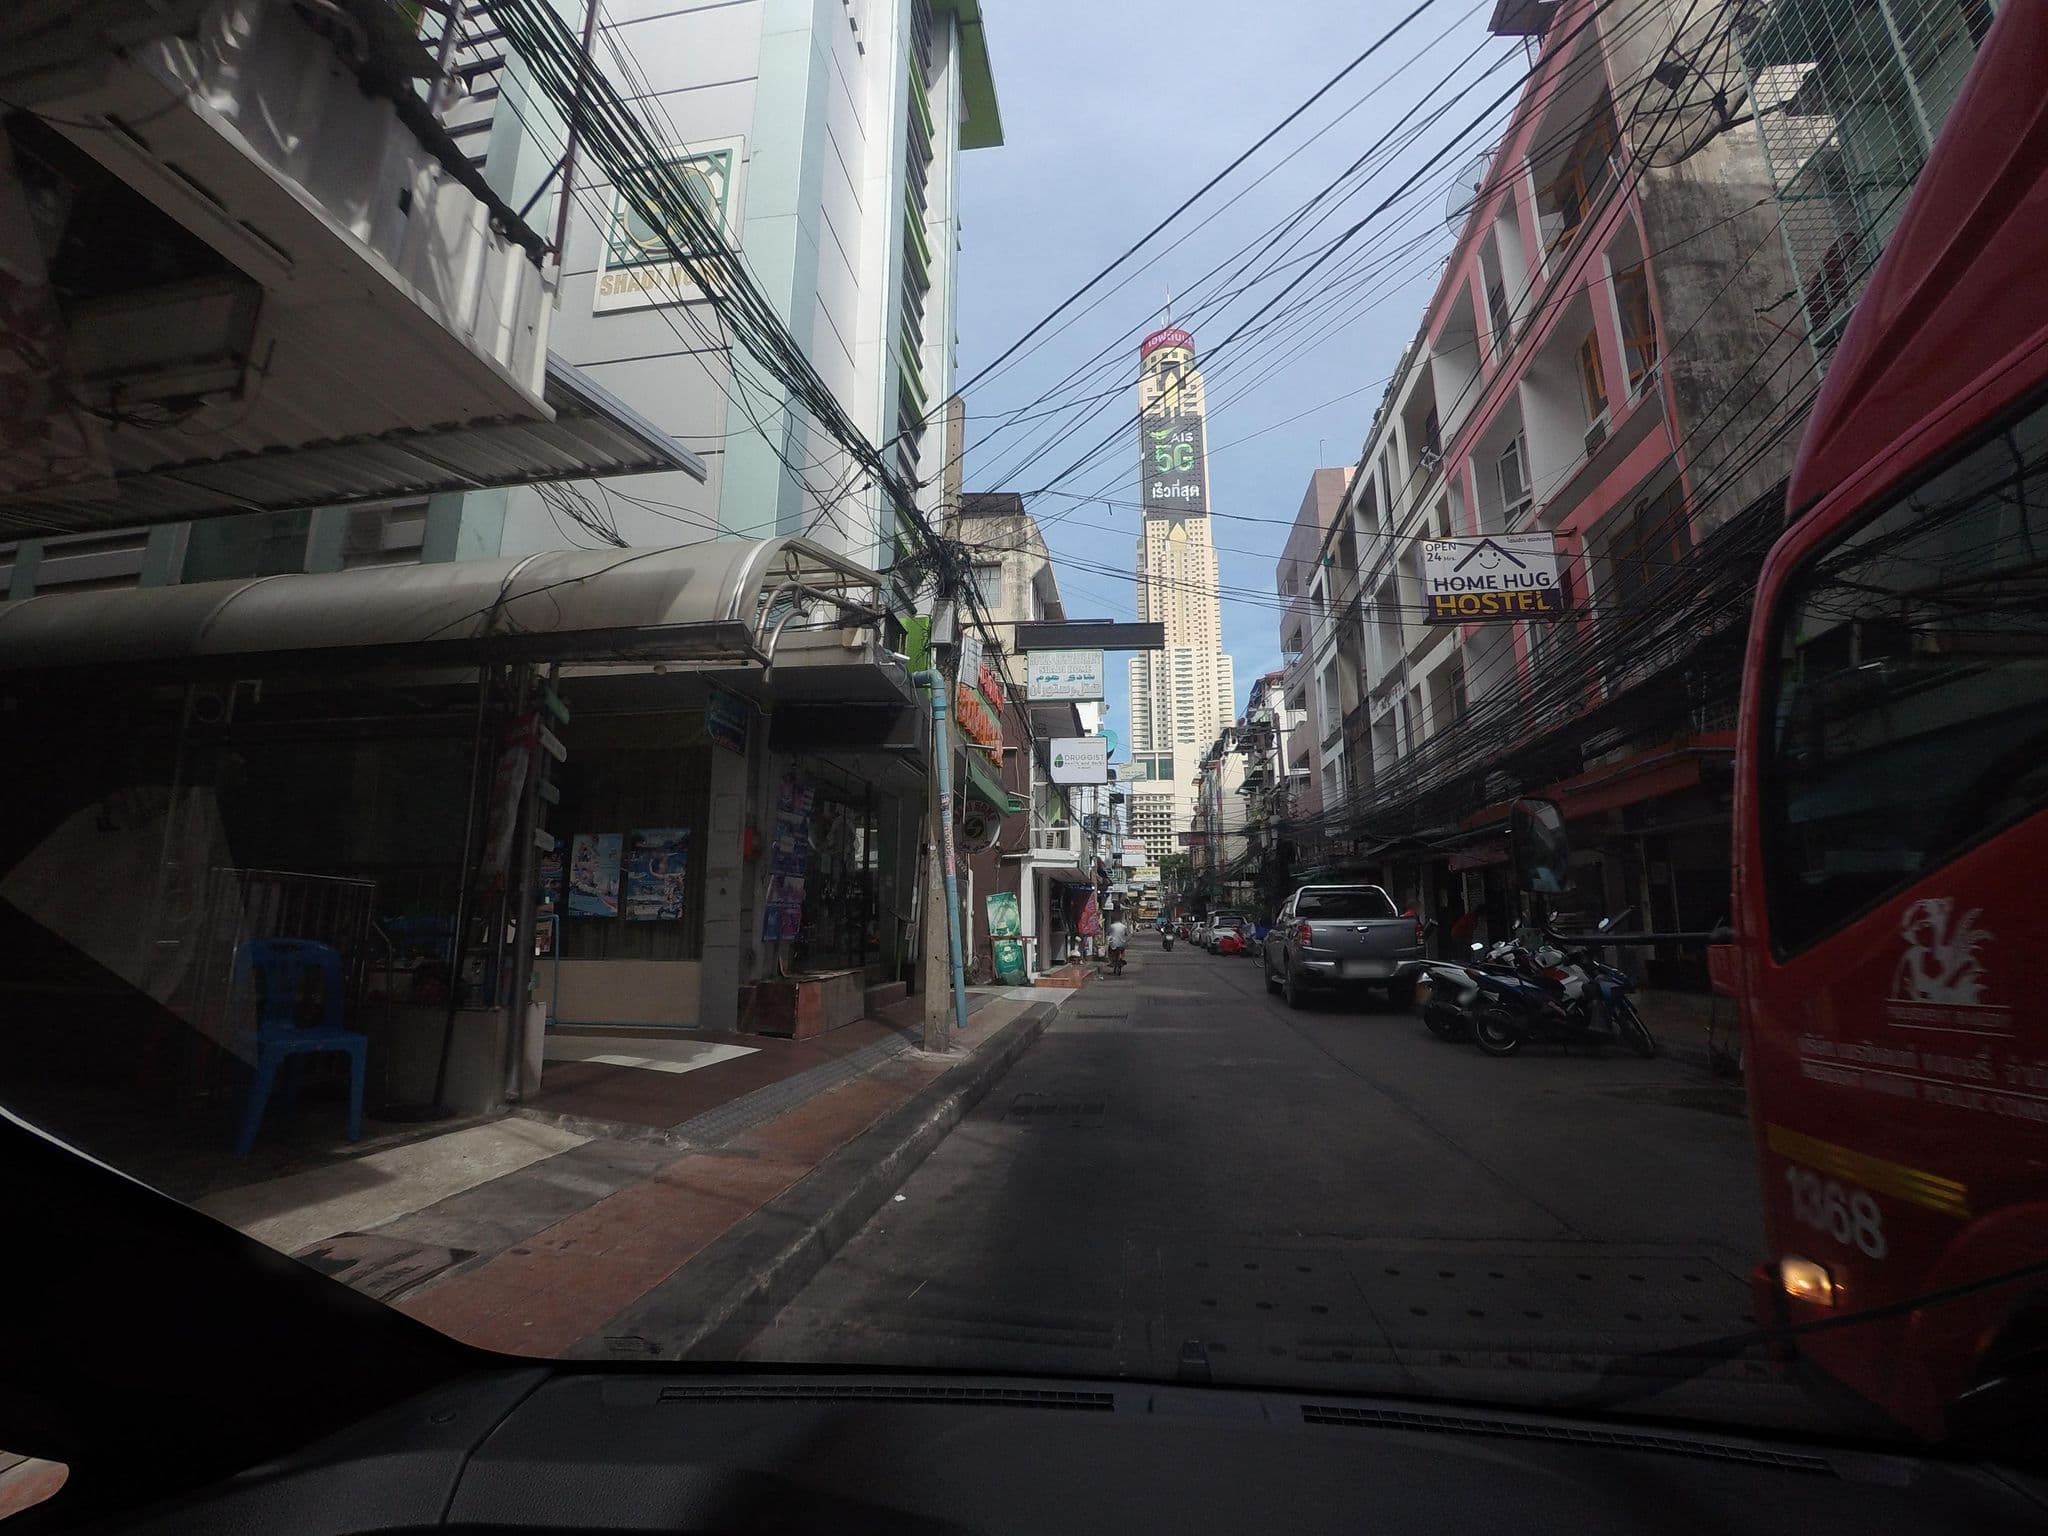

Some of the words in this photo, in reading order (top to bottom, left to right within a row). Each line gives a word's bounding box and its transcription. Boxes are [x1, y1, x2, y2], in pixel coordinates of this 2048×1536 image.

[1171, 432, 1194, 442] AIS
[1155, 443, 1194, 472] 5G
[1152, 479, 1200, 501] เร็วที่สุด
[1425, 543, 1457, 552] OPEN
[1427, 553, 1442, 562] 24
[1434, 575, 1498, 592] HOME
[1503, 572, 1550, 589] HUG
[1436, 591, 1553, 616] HOSTEL
[1786, 1166, 1888, 1260] 1368
